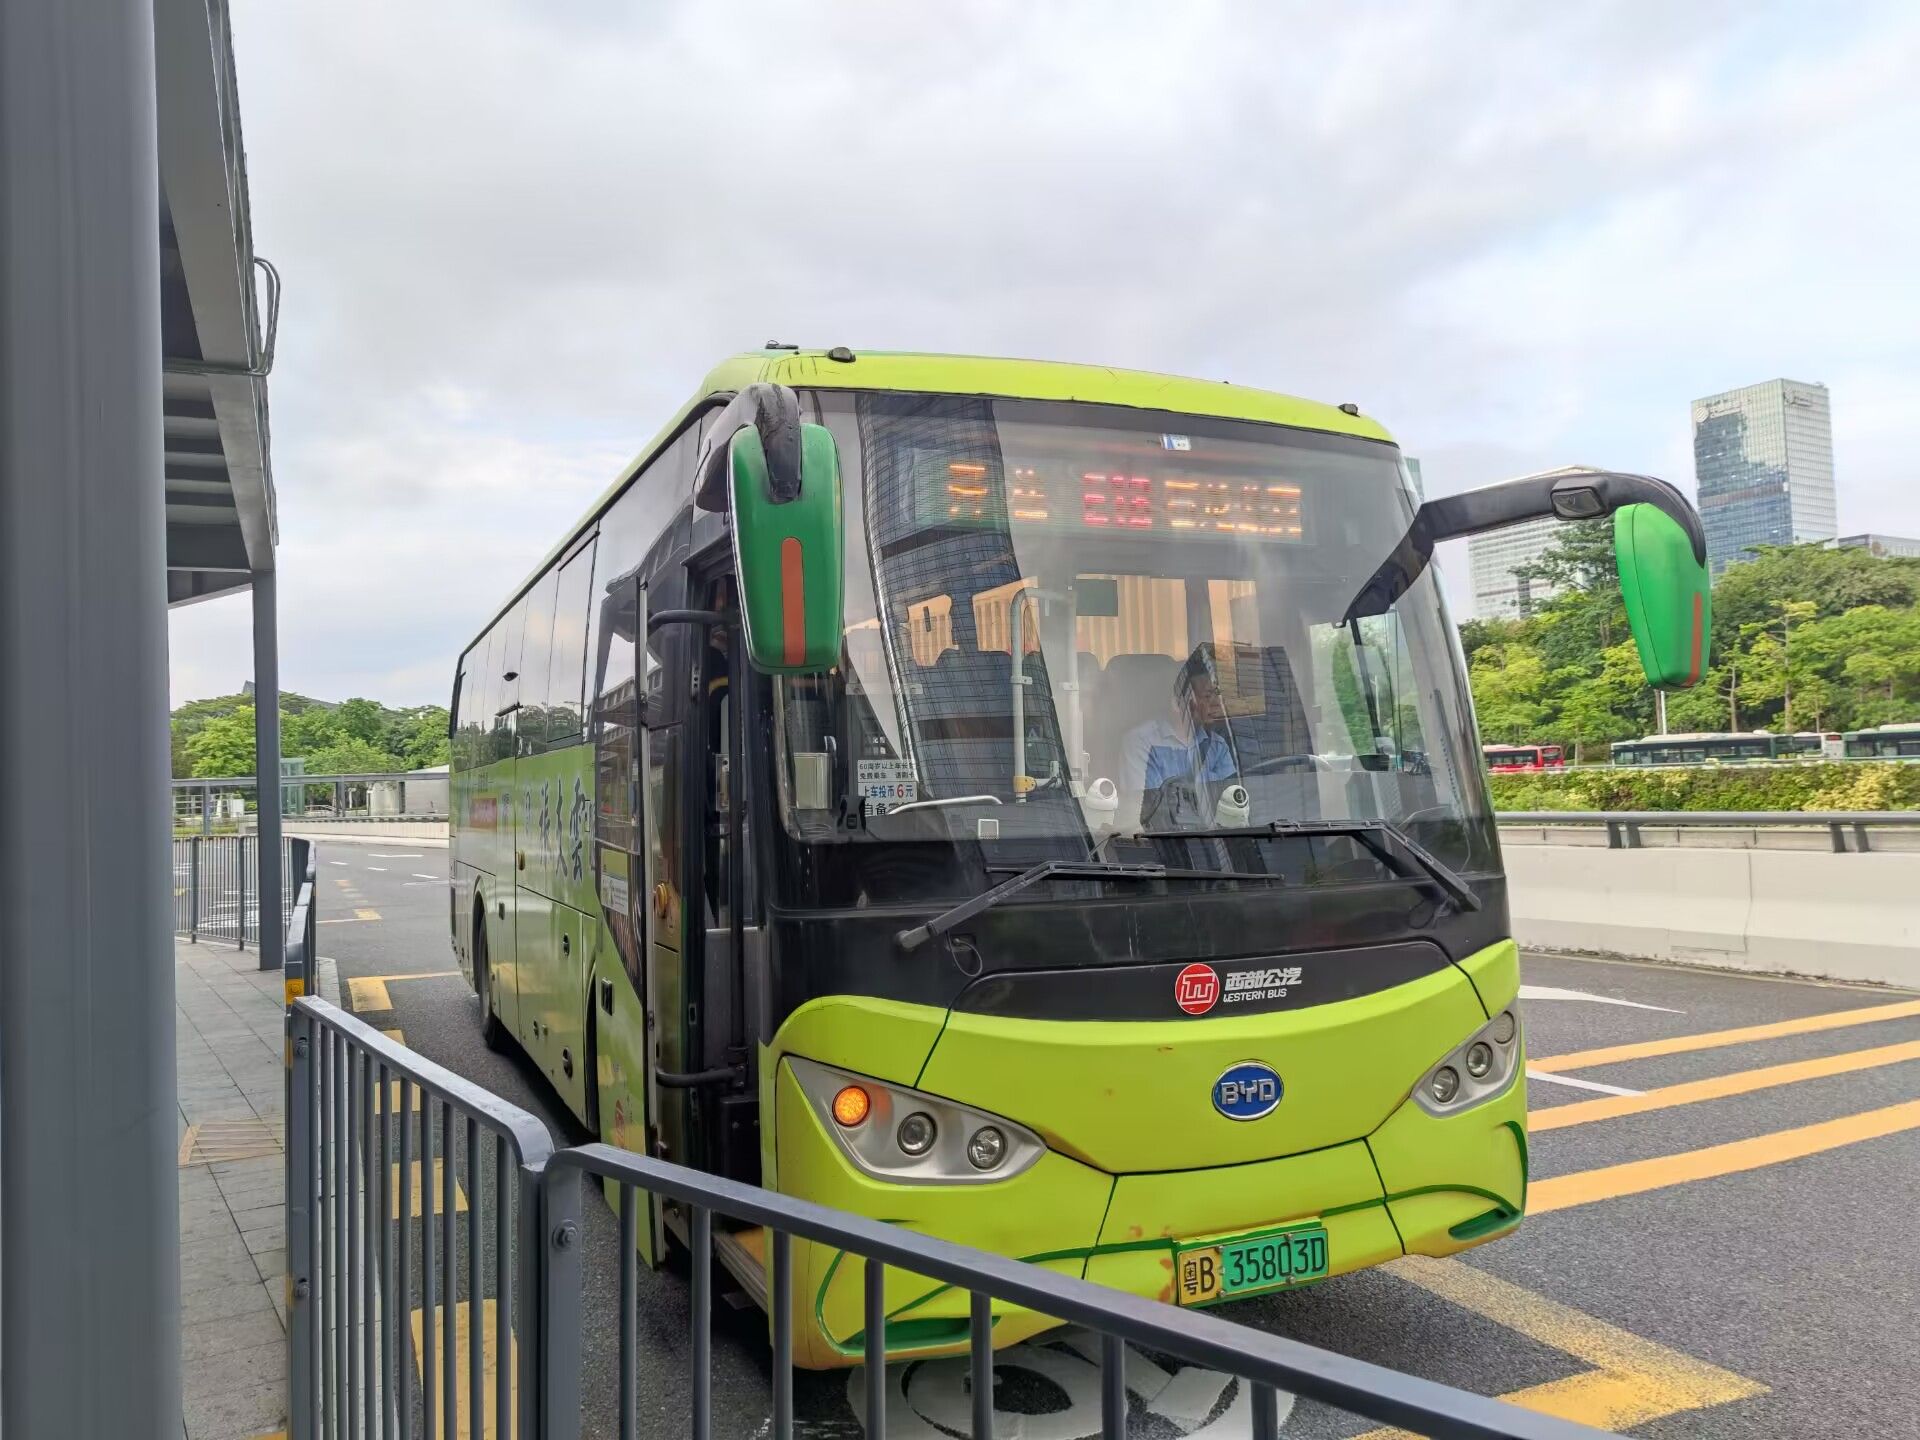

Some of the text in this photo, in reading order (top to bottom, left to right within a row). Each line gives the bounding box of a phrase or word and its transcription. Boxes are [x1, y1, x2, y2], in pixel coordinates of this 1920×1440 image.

[864, 783, 914, 799] 上车投币6元
[1267, 988, 1288, 999] BUS
[1221, 1078, 1275, 1105] BYD
[1183, 1237, 1326, 1296] 粤B 35803D
